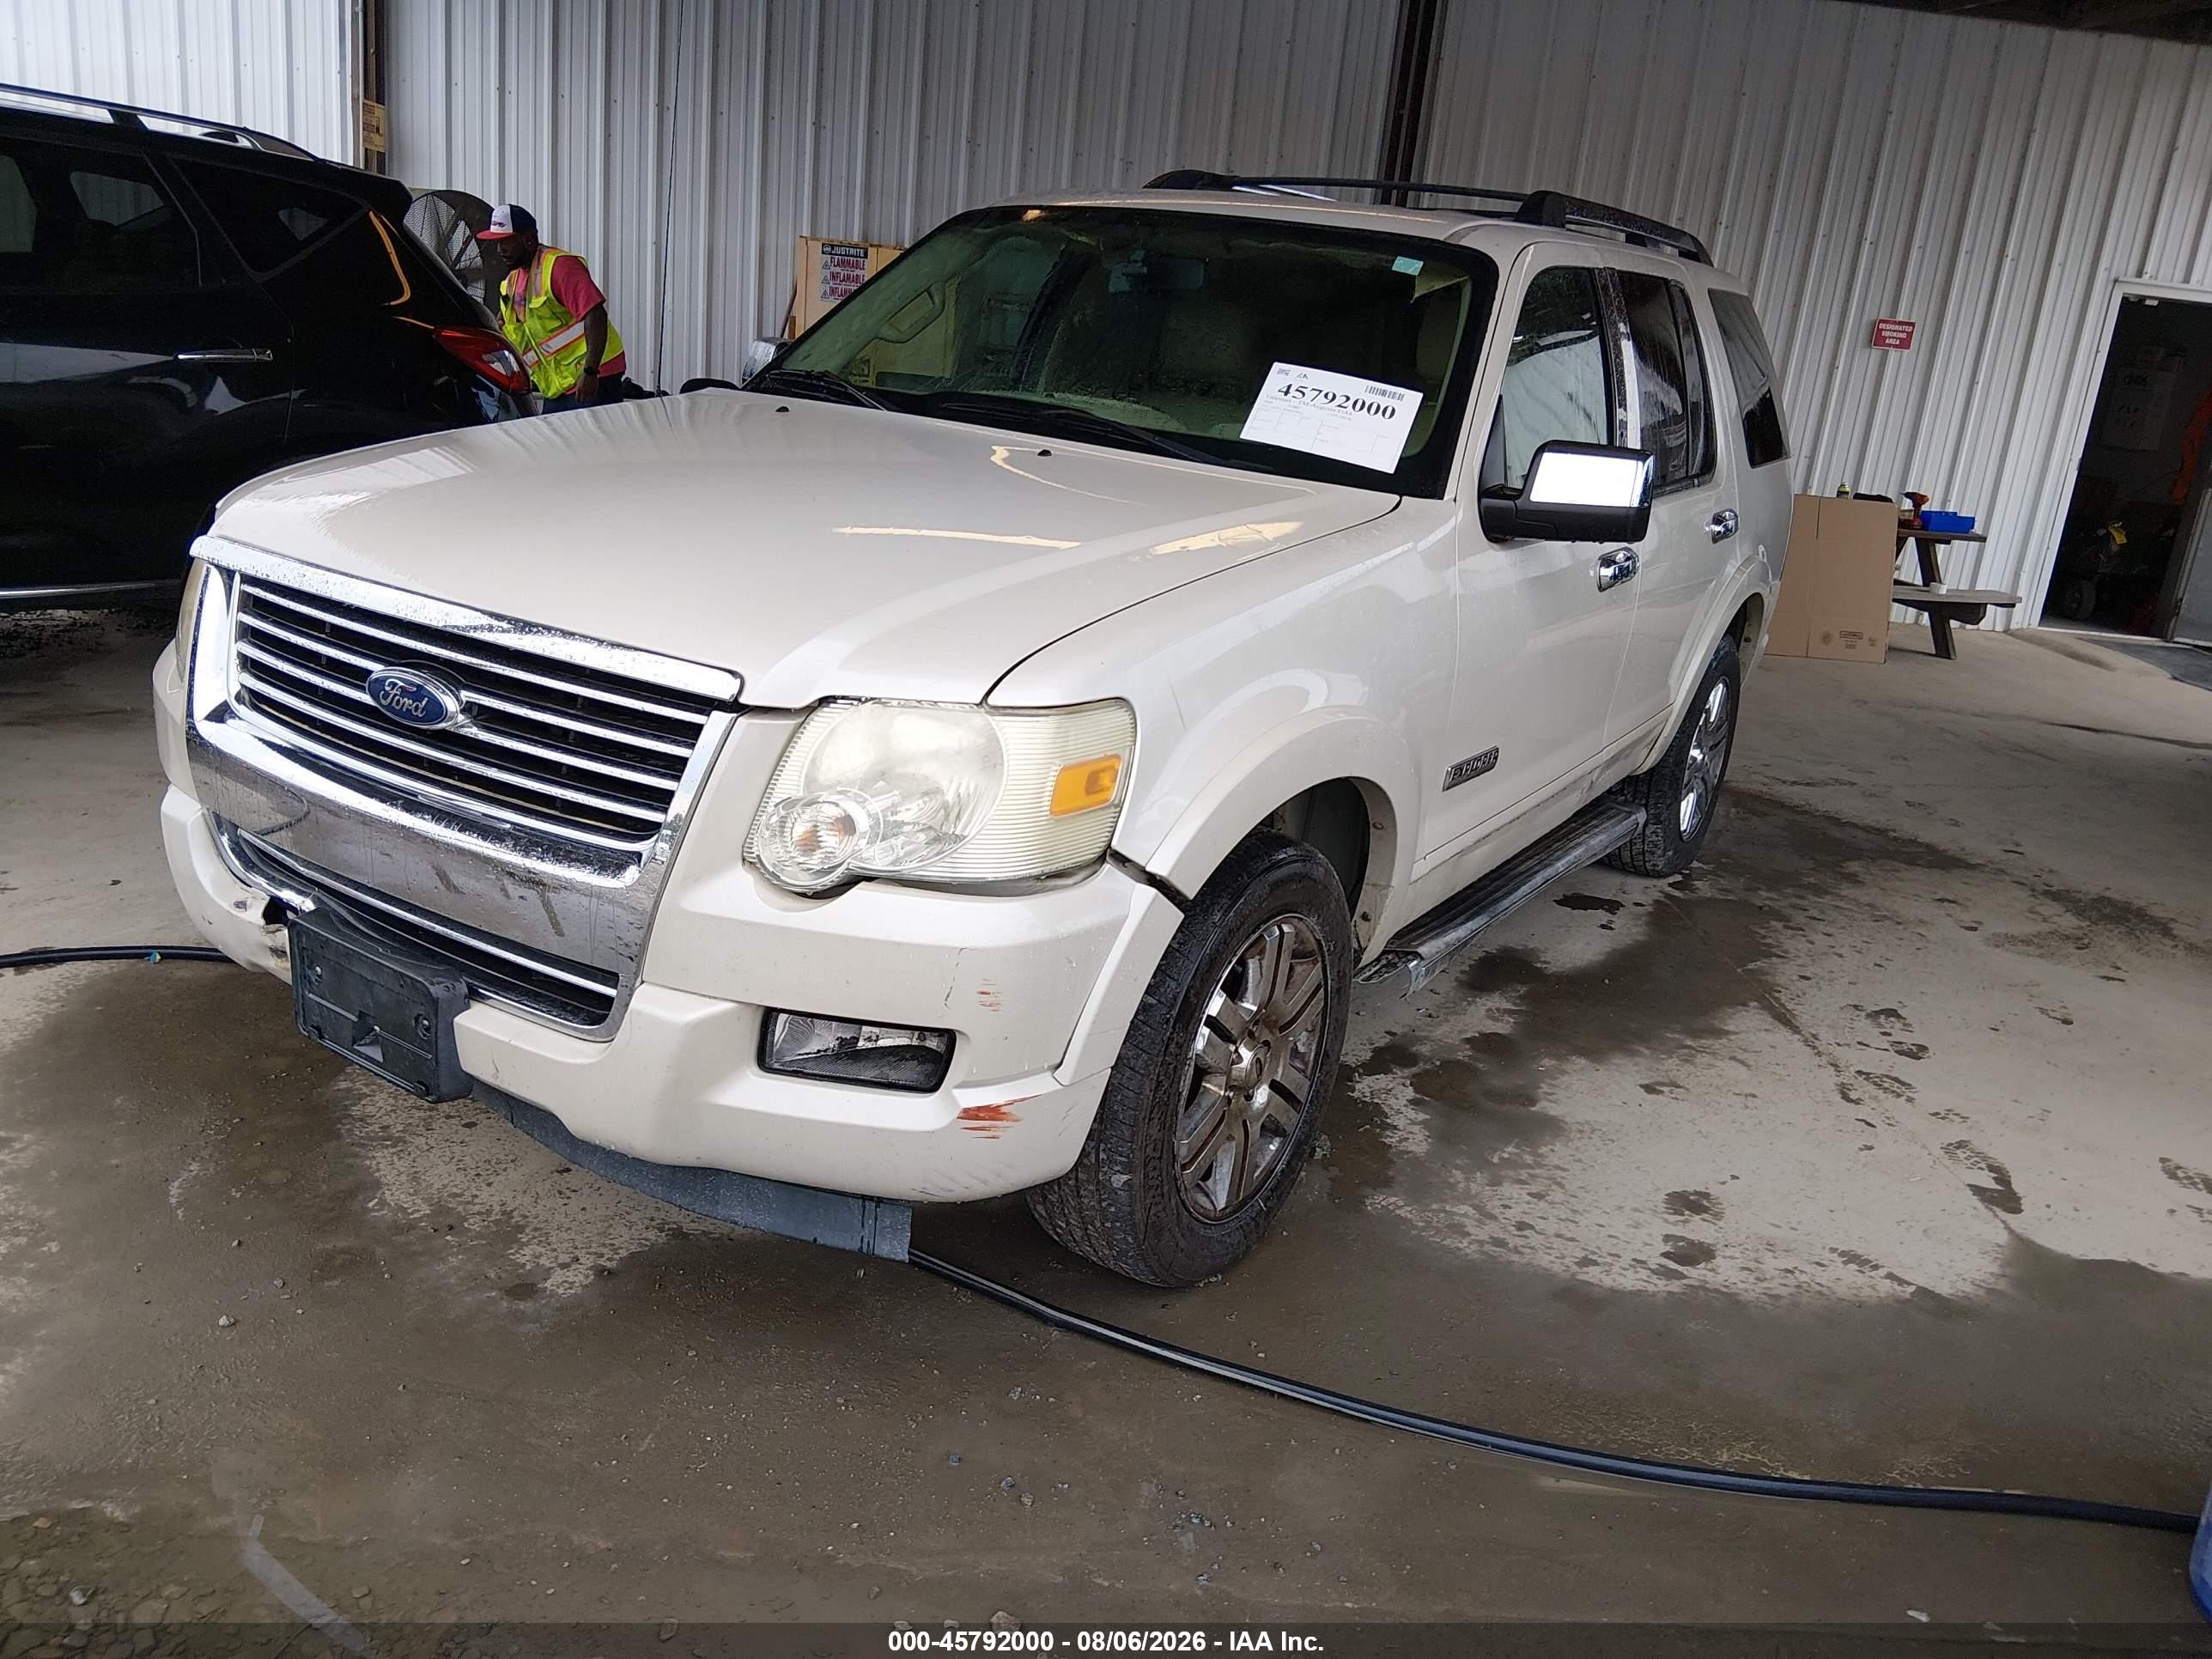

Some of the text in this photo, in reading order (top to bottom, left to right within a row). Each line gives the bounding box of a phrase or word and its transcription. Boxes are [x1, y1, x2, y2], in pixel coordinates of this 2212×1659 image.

[831, 246, 865, 257] JUSTRITE
[830, 257, 866, 270] FLAMMABLE
[830, 271, 865, 284] INFLAMABLE
[1879, 323, 1913, 332] DESIGNATED
[1277, 383, 1396, 420] 45792000
[379, 678, 429, 718] Ford
[1449, 750, 1499, 782] EXPLORER
